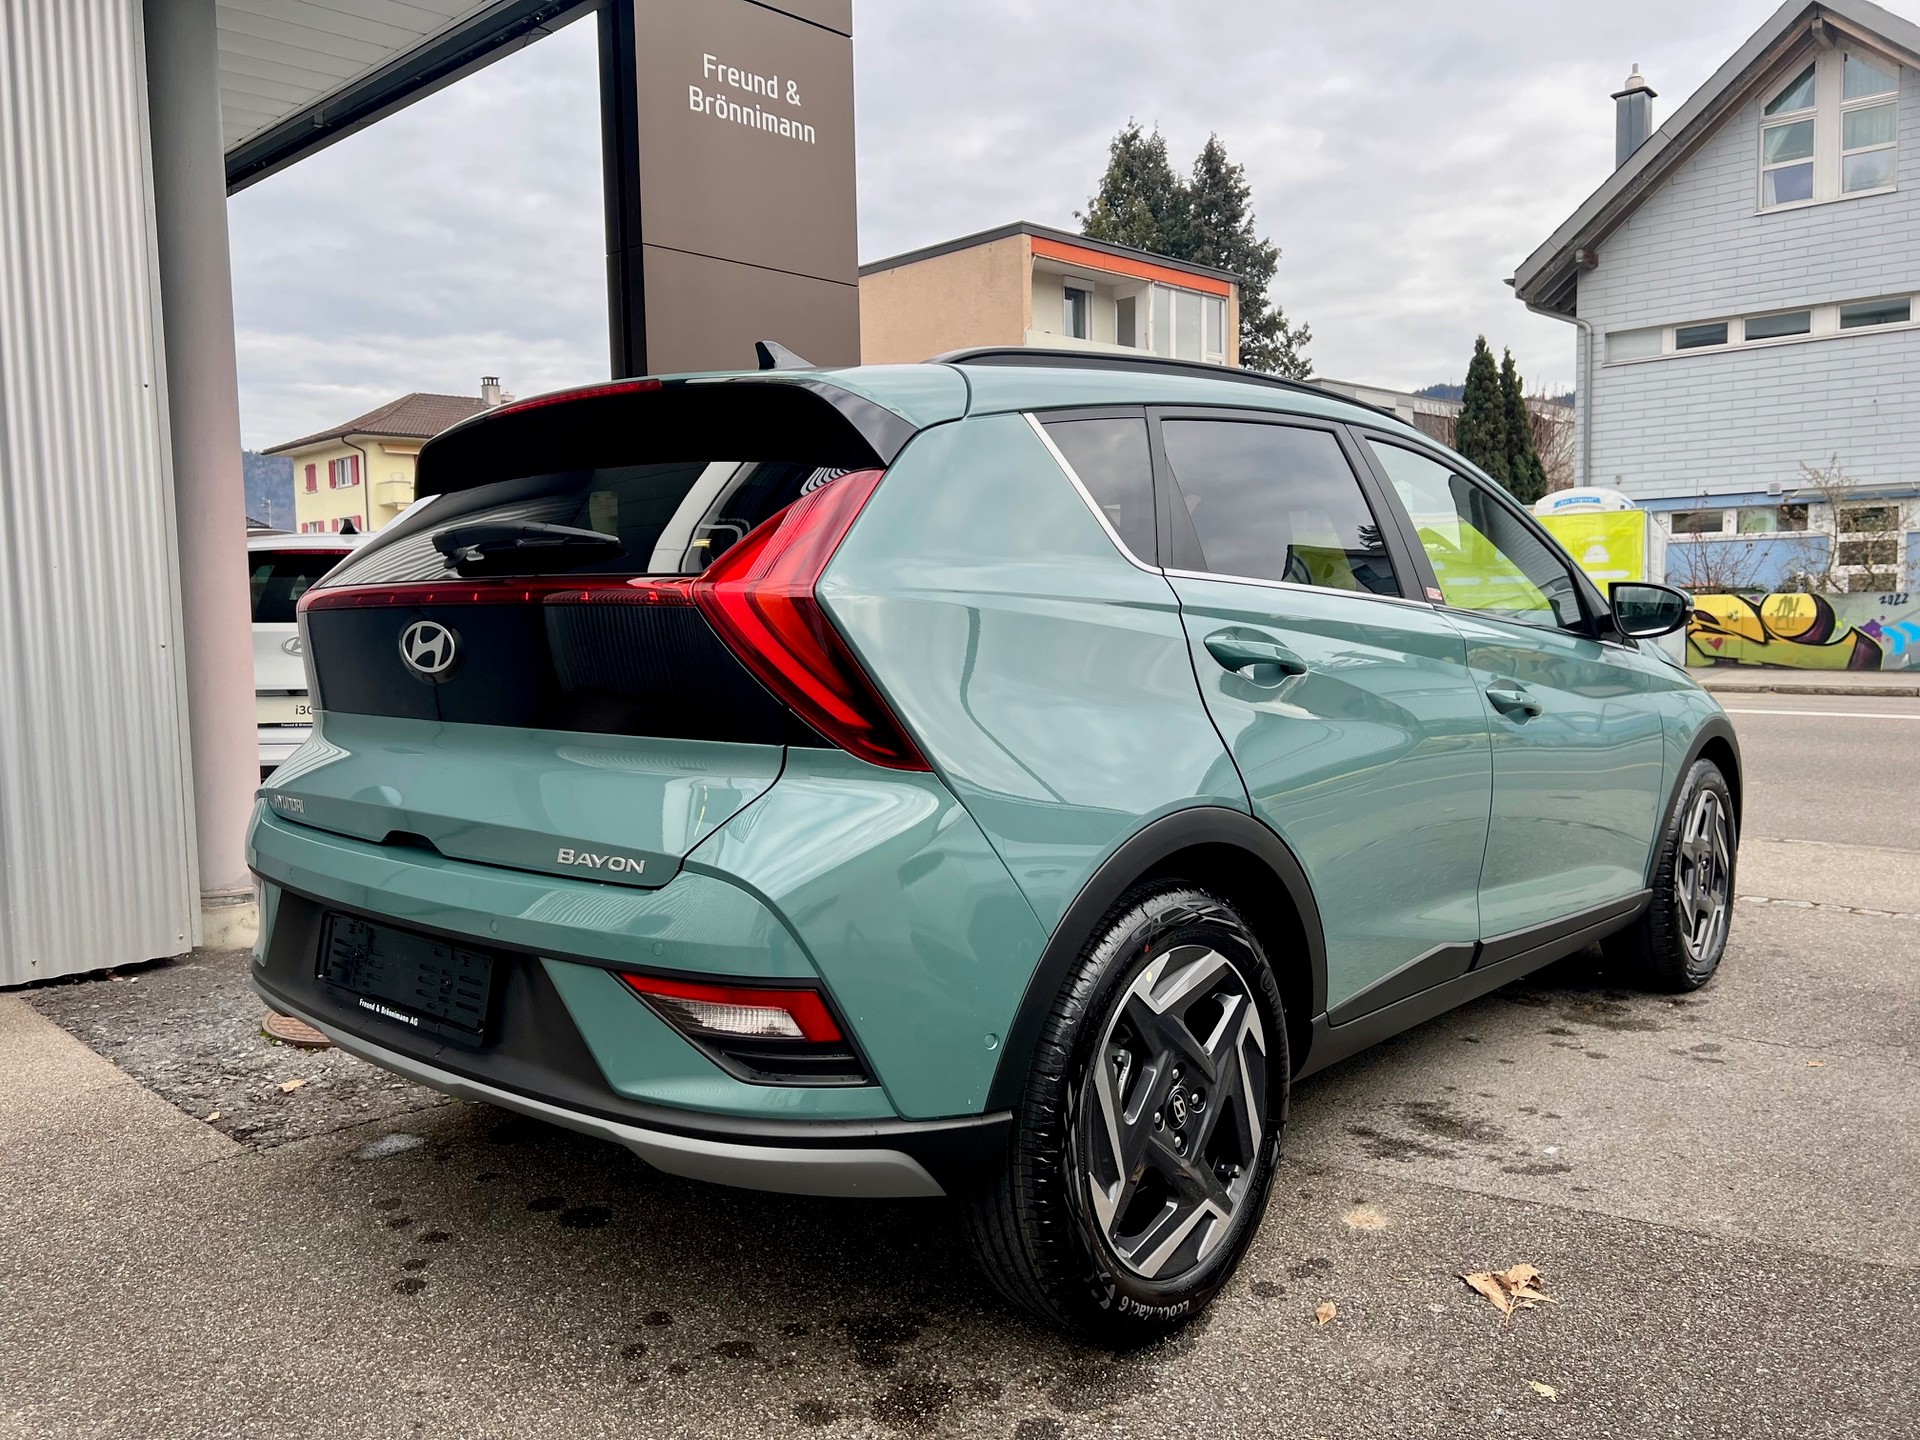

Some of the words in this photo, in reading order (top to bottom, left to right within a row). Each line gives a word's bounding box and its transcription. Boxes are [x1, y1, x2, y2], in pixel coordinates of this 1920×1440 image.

[703, 53, 778, 99] Freund
[785, 80, 801, 106] &
[689, 85, 815, 144] Brönnimann
[1879, 593, 1909, 605] 2022
[557, 848, 645, 874] BAYON
[359, 998, 375, 1010] Freund
[410, 1016, 418, 1026] AG
